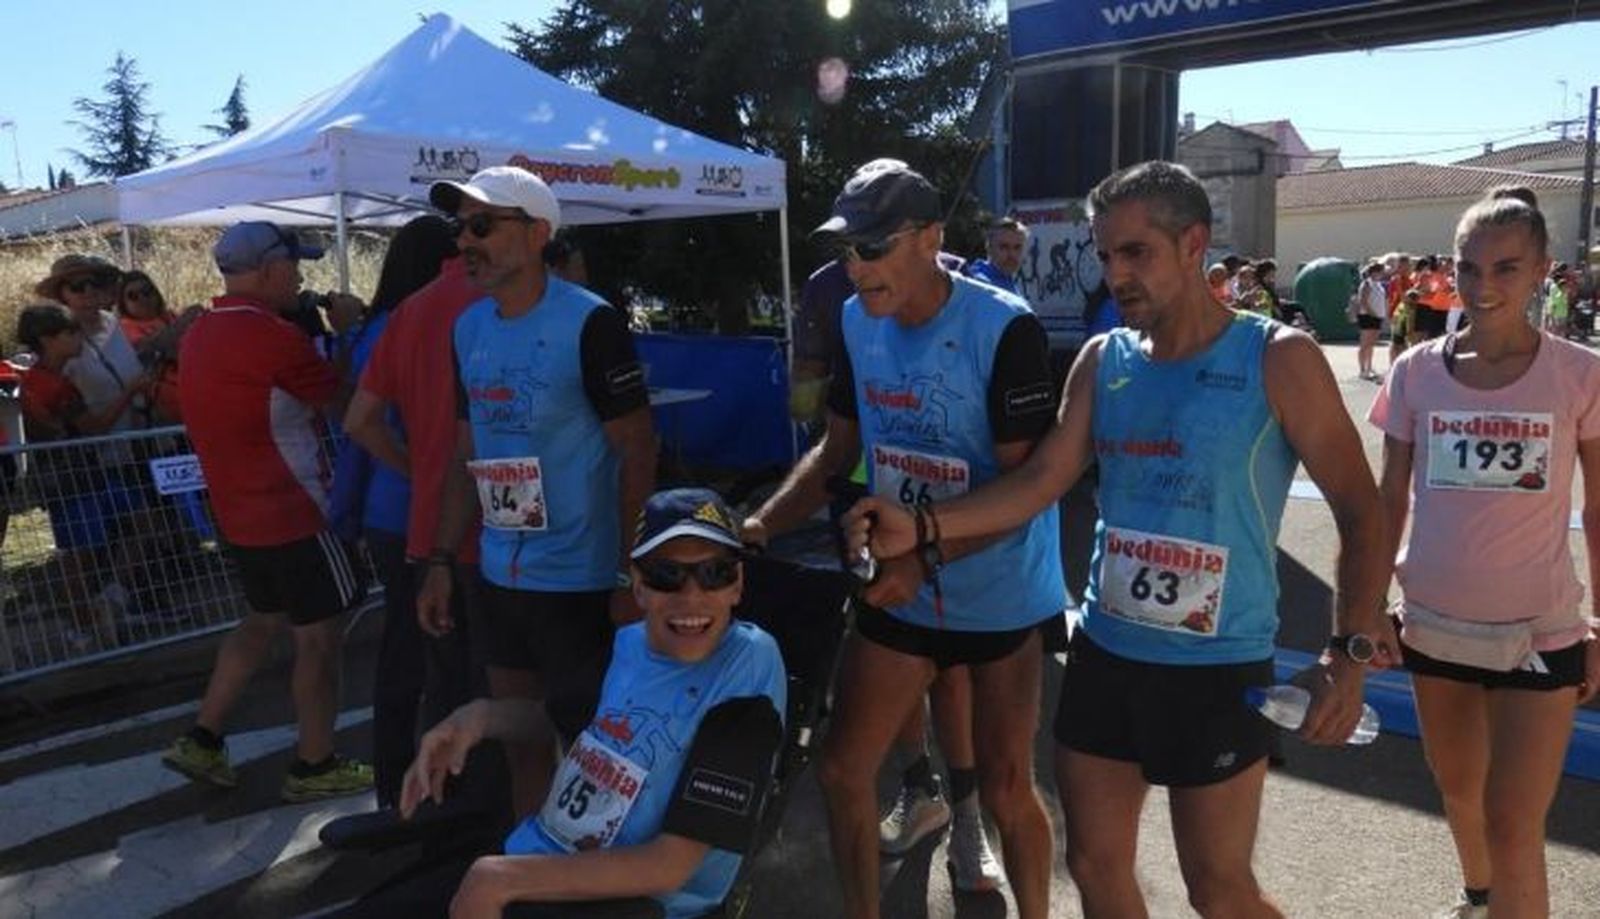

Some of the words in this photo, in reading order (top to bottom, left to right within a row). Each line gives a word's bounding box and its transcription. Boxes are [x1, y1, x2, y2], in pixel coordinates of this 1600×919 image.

[1453, 439, 1524, 471] 193
[491, 486, 517, 511] 64
[899, 479, 933, 504] 66
[1130, 566, 1180, 606] 63
[557, 775, 597, 820] 65
